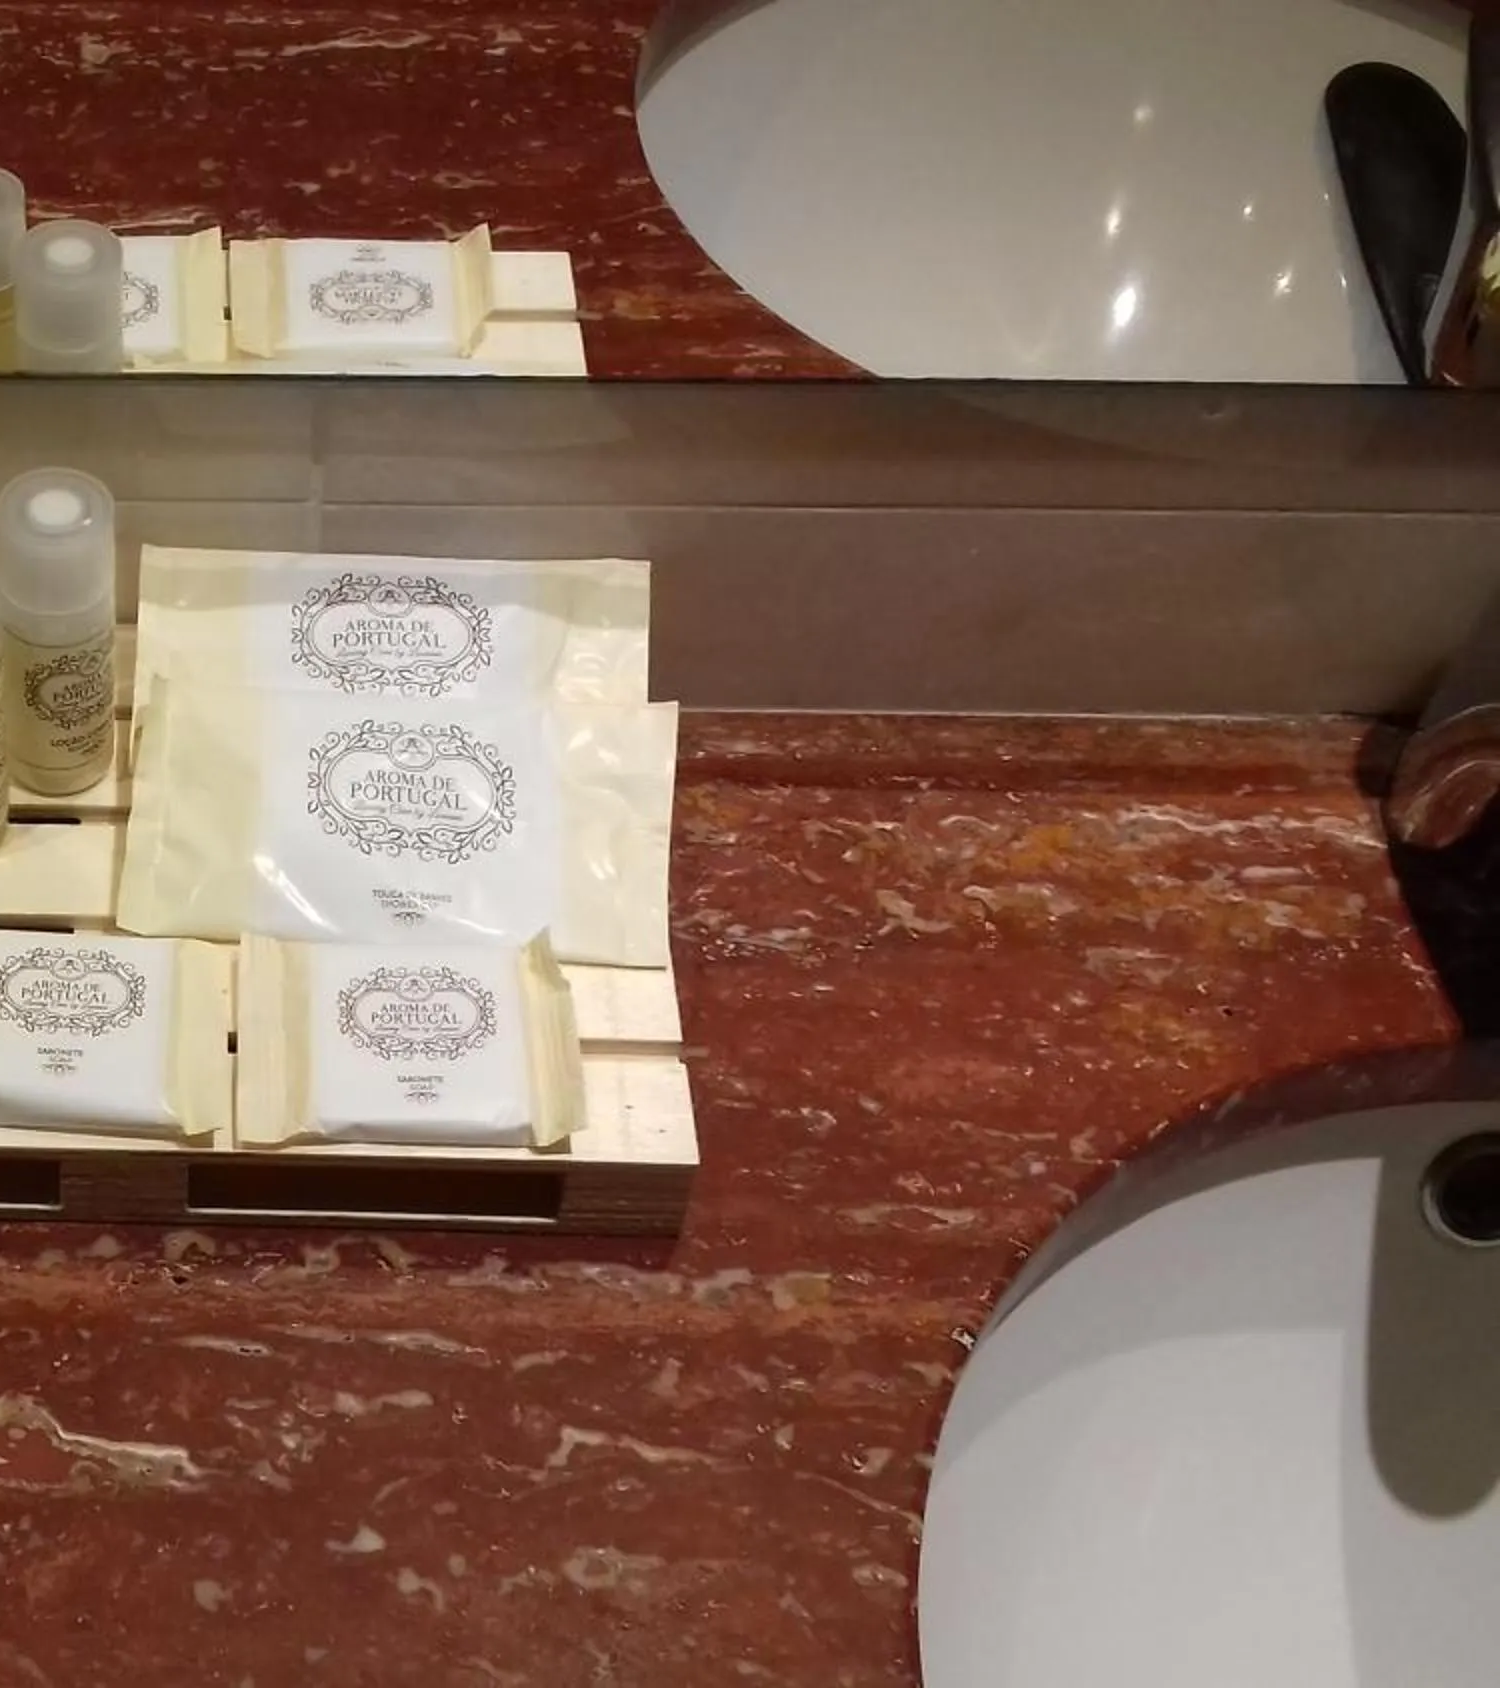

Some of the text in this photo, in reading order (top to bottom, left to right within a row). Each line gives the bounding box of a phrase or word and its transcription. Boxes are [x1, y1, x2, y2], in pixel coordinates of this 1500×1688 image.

[344, 618, 434, 633] AROMA DE
[332, 630, 448, 649] PORTUGAL
[364, 769, 458, 793] AROMA DE
[349, 781, 469, 812] PORTUGAL
[32, 979, 81, 992] AROMA
[20, 986, 110, 1004] PORTUGAL
[379, 1002, 451, 1013] AROMA DE
[370, 1010, 463, 1025] PORTUGAL
